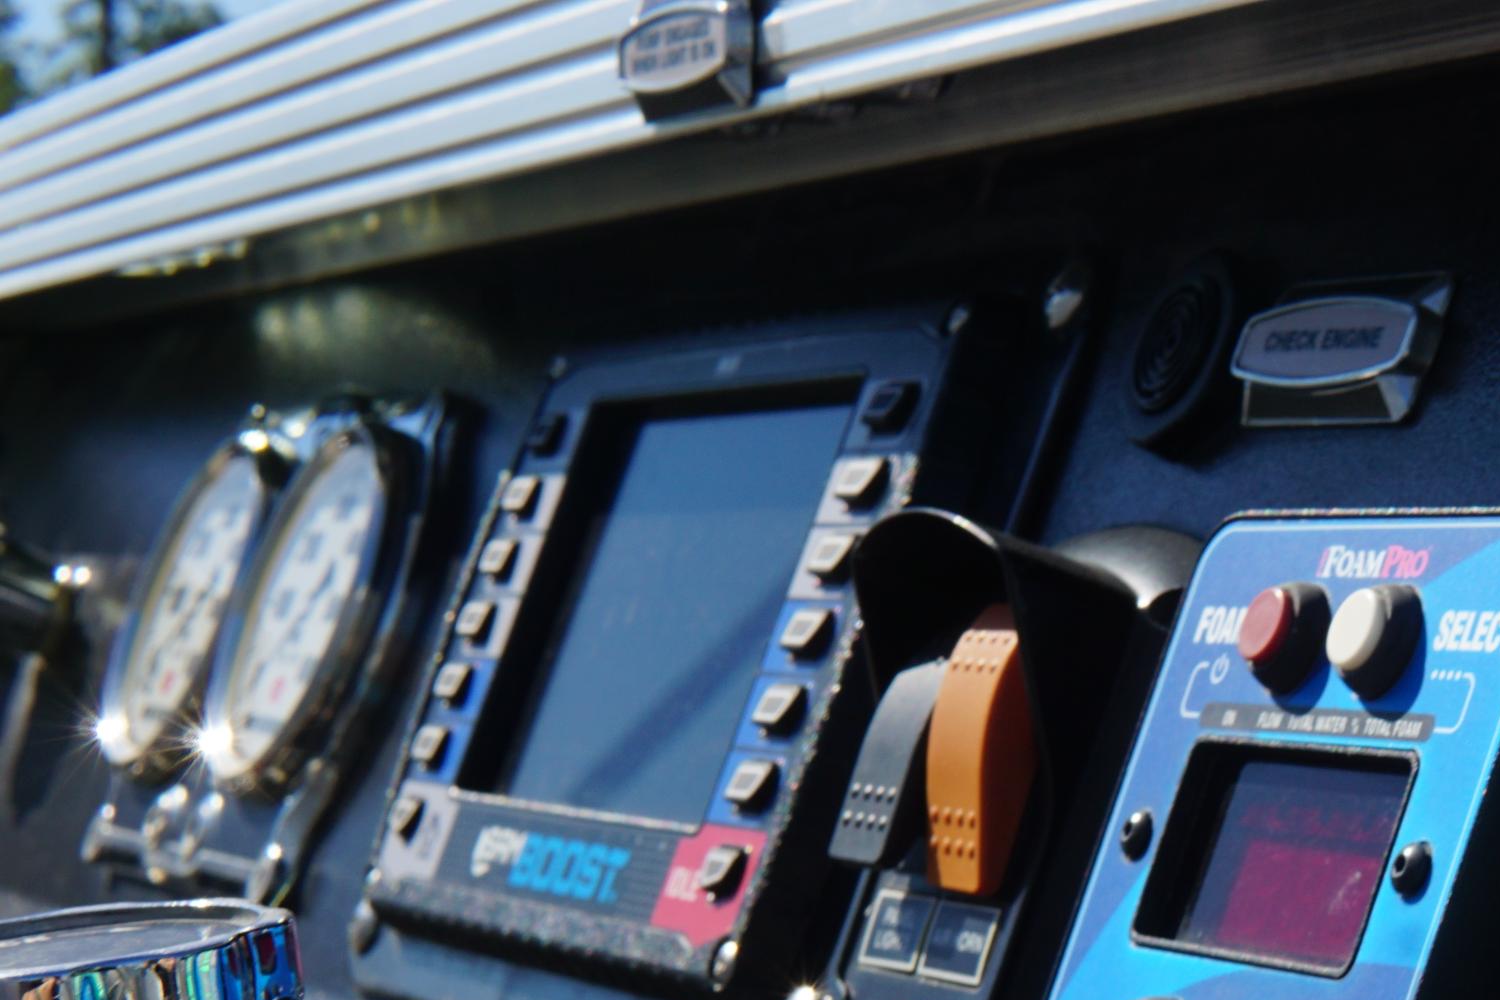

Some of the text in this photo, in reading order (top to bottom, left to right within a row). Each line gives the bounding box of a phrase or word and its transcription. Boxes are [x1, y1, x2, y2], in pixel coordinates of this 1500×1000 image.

[1264, 325, 1385, 353] CHECK ENGINE
[1314, 715, 1348, 734] WATER
